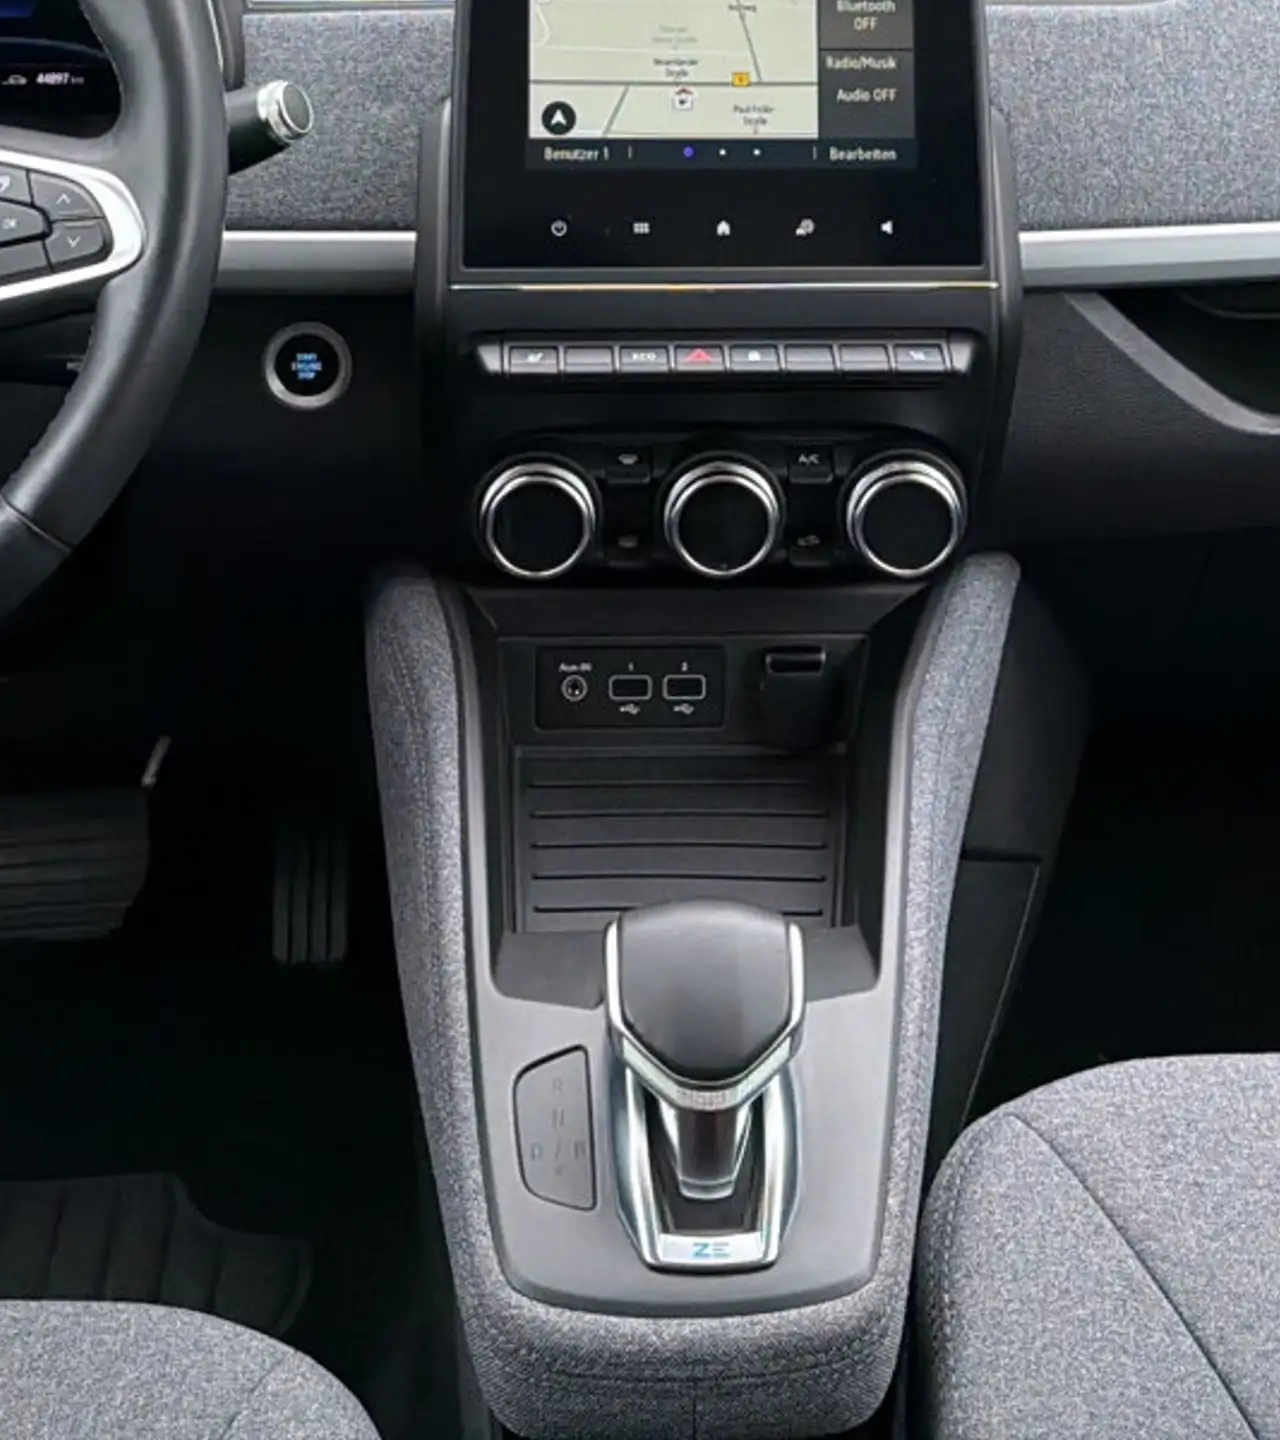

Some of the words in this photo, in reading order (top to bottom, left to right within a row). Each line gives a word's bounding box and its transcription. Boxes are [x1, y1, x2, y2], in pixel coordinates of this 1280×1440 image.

[853, 16, 878, 30] OFF
[826, 56, 897, 70] Radio/Musik
[836, 88, 871, 101] Audio
[872, 88, 897, 101] OFF
[544, 146, 599, 161] Benutzer
[829, 147, 897, 161] Bearbeiten
